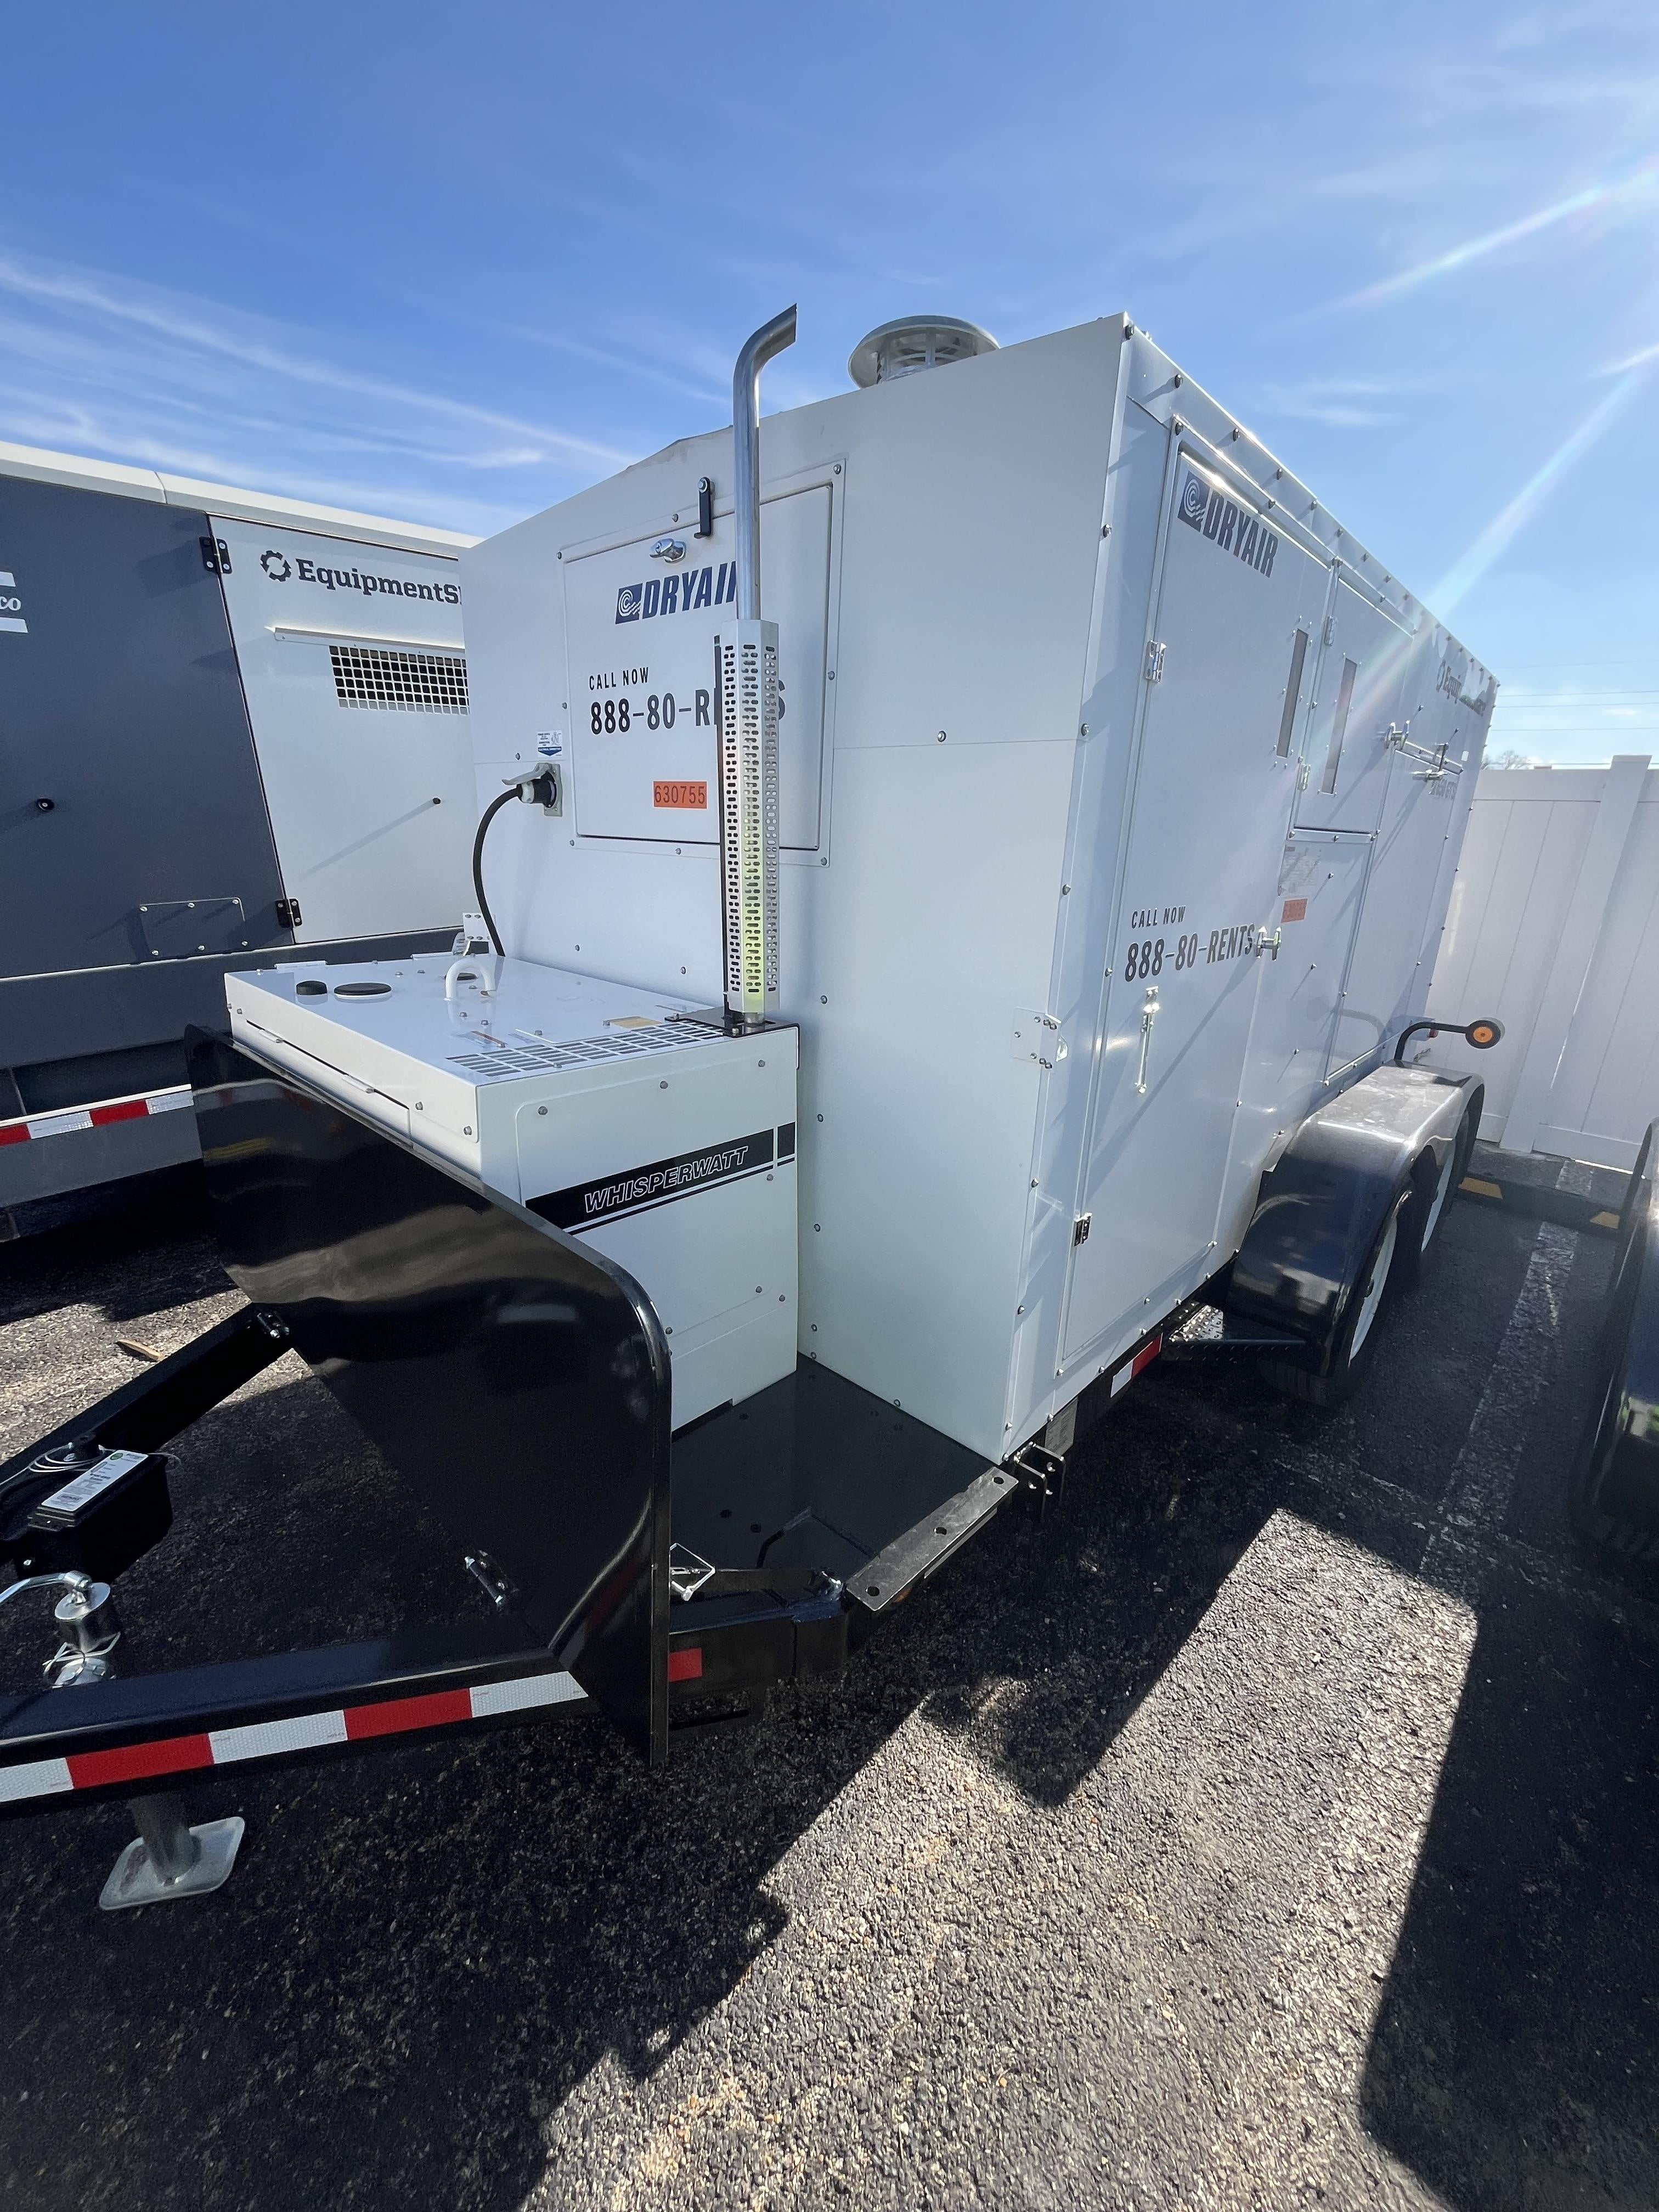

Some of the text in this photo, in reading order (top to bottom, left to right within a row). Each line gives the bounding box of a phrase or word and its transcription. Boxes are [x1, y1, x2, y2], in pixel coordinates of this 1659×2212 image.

[1203, 489, 1279, 579] DRYAIR
[295, 558, 462, 605] EquipmentS
[589, 667, 648, 690] CALL NOW
[654, 785, 705, 804] 630755
[1131, 906, 1186, 929] CALL NOW
[1125, 924, 1255, 982] 888-80-RENTS
[584, 1146, 748, 1213] WHISPERWATT
